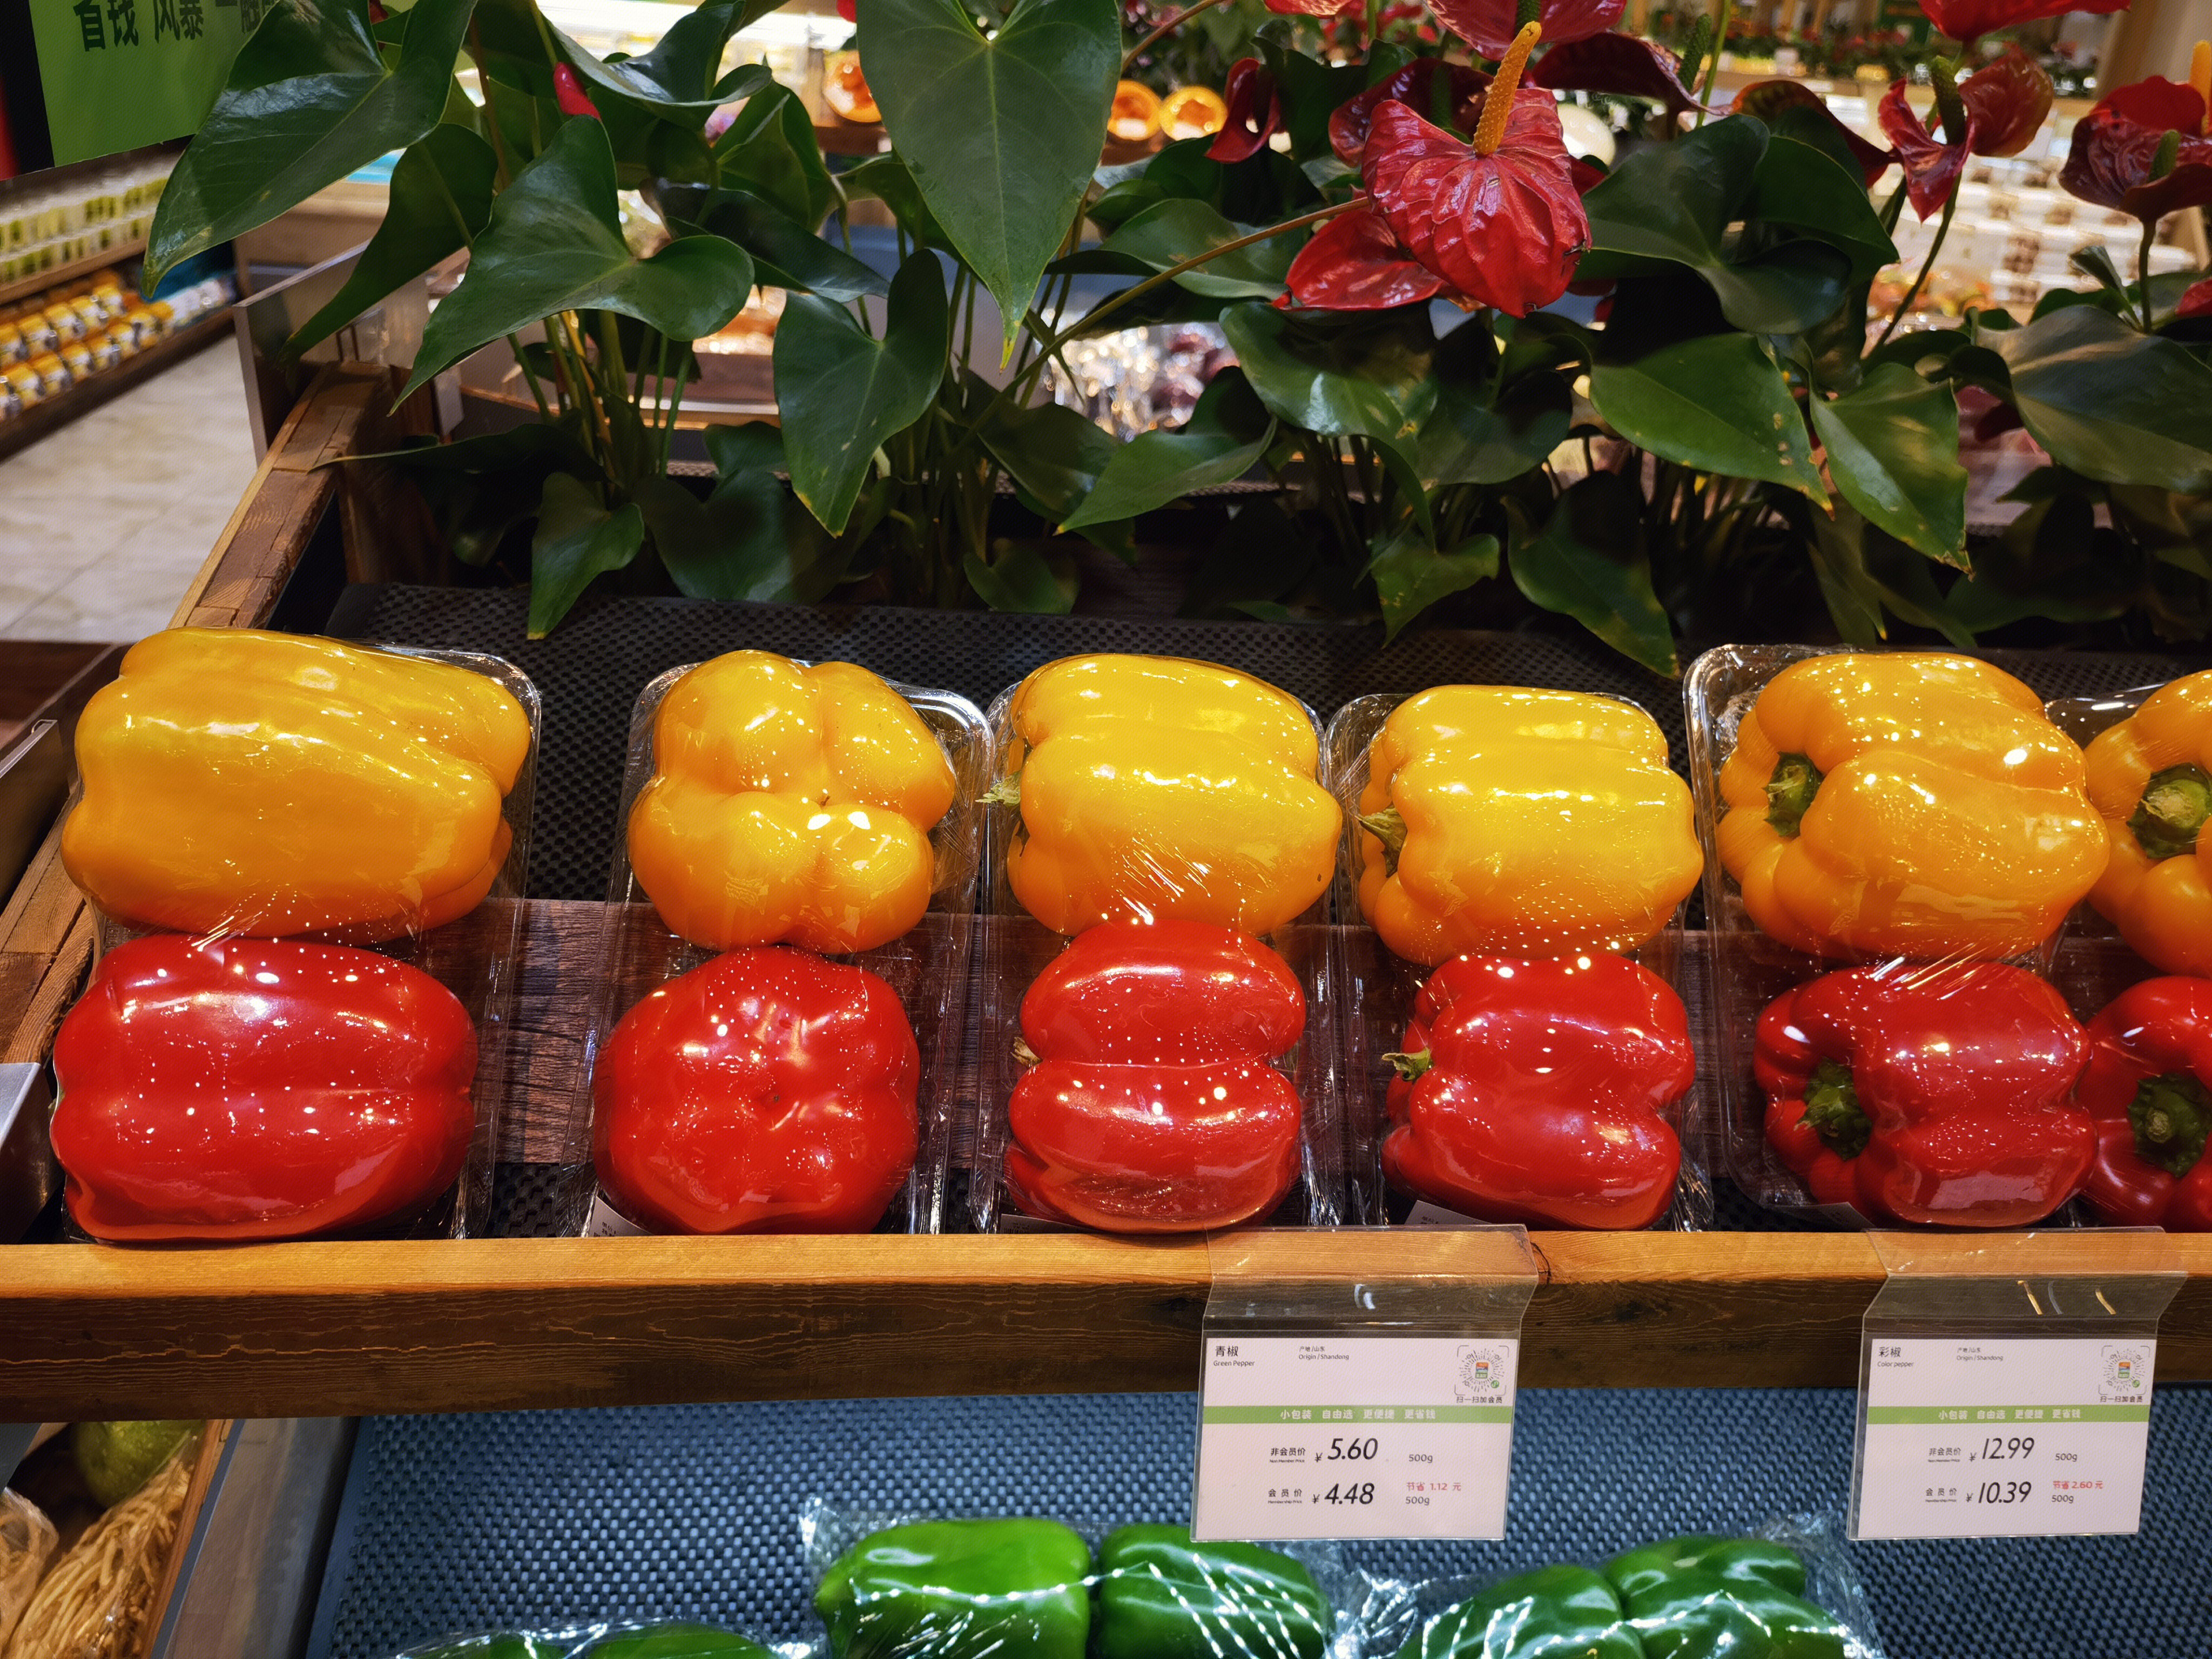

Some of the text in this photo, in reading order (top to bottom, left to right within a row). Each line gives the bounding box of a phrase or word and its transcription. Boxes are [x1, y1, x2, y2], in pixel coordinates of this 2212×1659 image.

[1215, 1345, 1239, 1357] 青椒
[1879, 1346, 1901, 1358] 彩椒
[1280, 1409, 1437, 1419] 小包装 自由选 更便捷 更省钱
[1938, 1410, 1968, 1420] 小包装
[1977, 1410, 2006, 1419] 自由选
[1270, 1447, 1306, 1456] 非会员价
[1327, 1438, 1378, 1460] 5.60
[1928, 1447, 1961, 1456] 非会员价
[1982, 1437, 2035, 1459] 12.99
[1408, 1454, 1433, 1464] 500g
[2055, 1453, 2078, 1462] 500g
[1406, 1481, 1461, 1491] 节省 1.12 元
[2053, 1480, 2103, 1489] 节省 2.60 元
[1324, 1482, 1375, 1505] 4.48
[1978, 1481, 2032, 1503] 10.39
[1405, 1496, 1430, 1506] 500g
[2051, 1495, 2074, 1503] 500g
